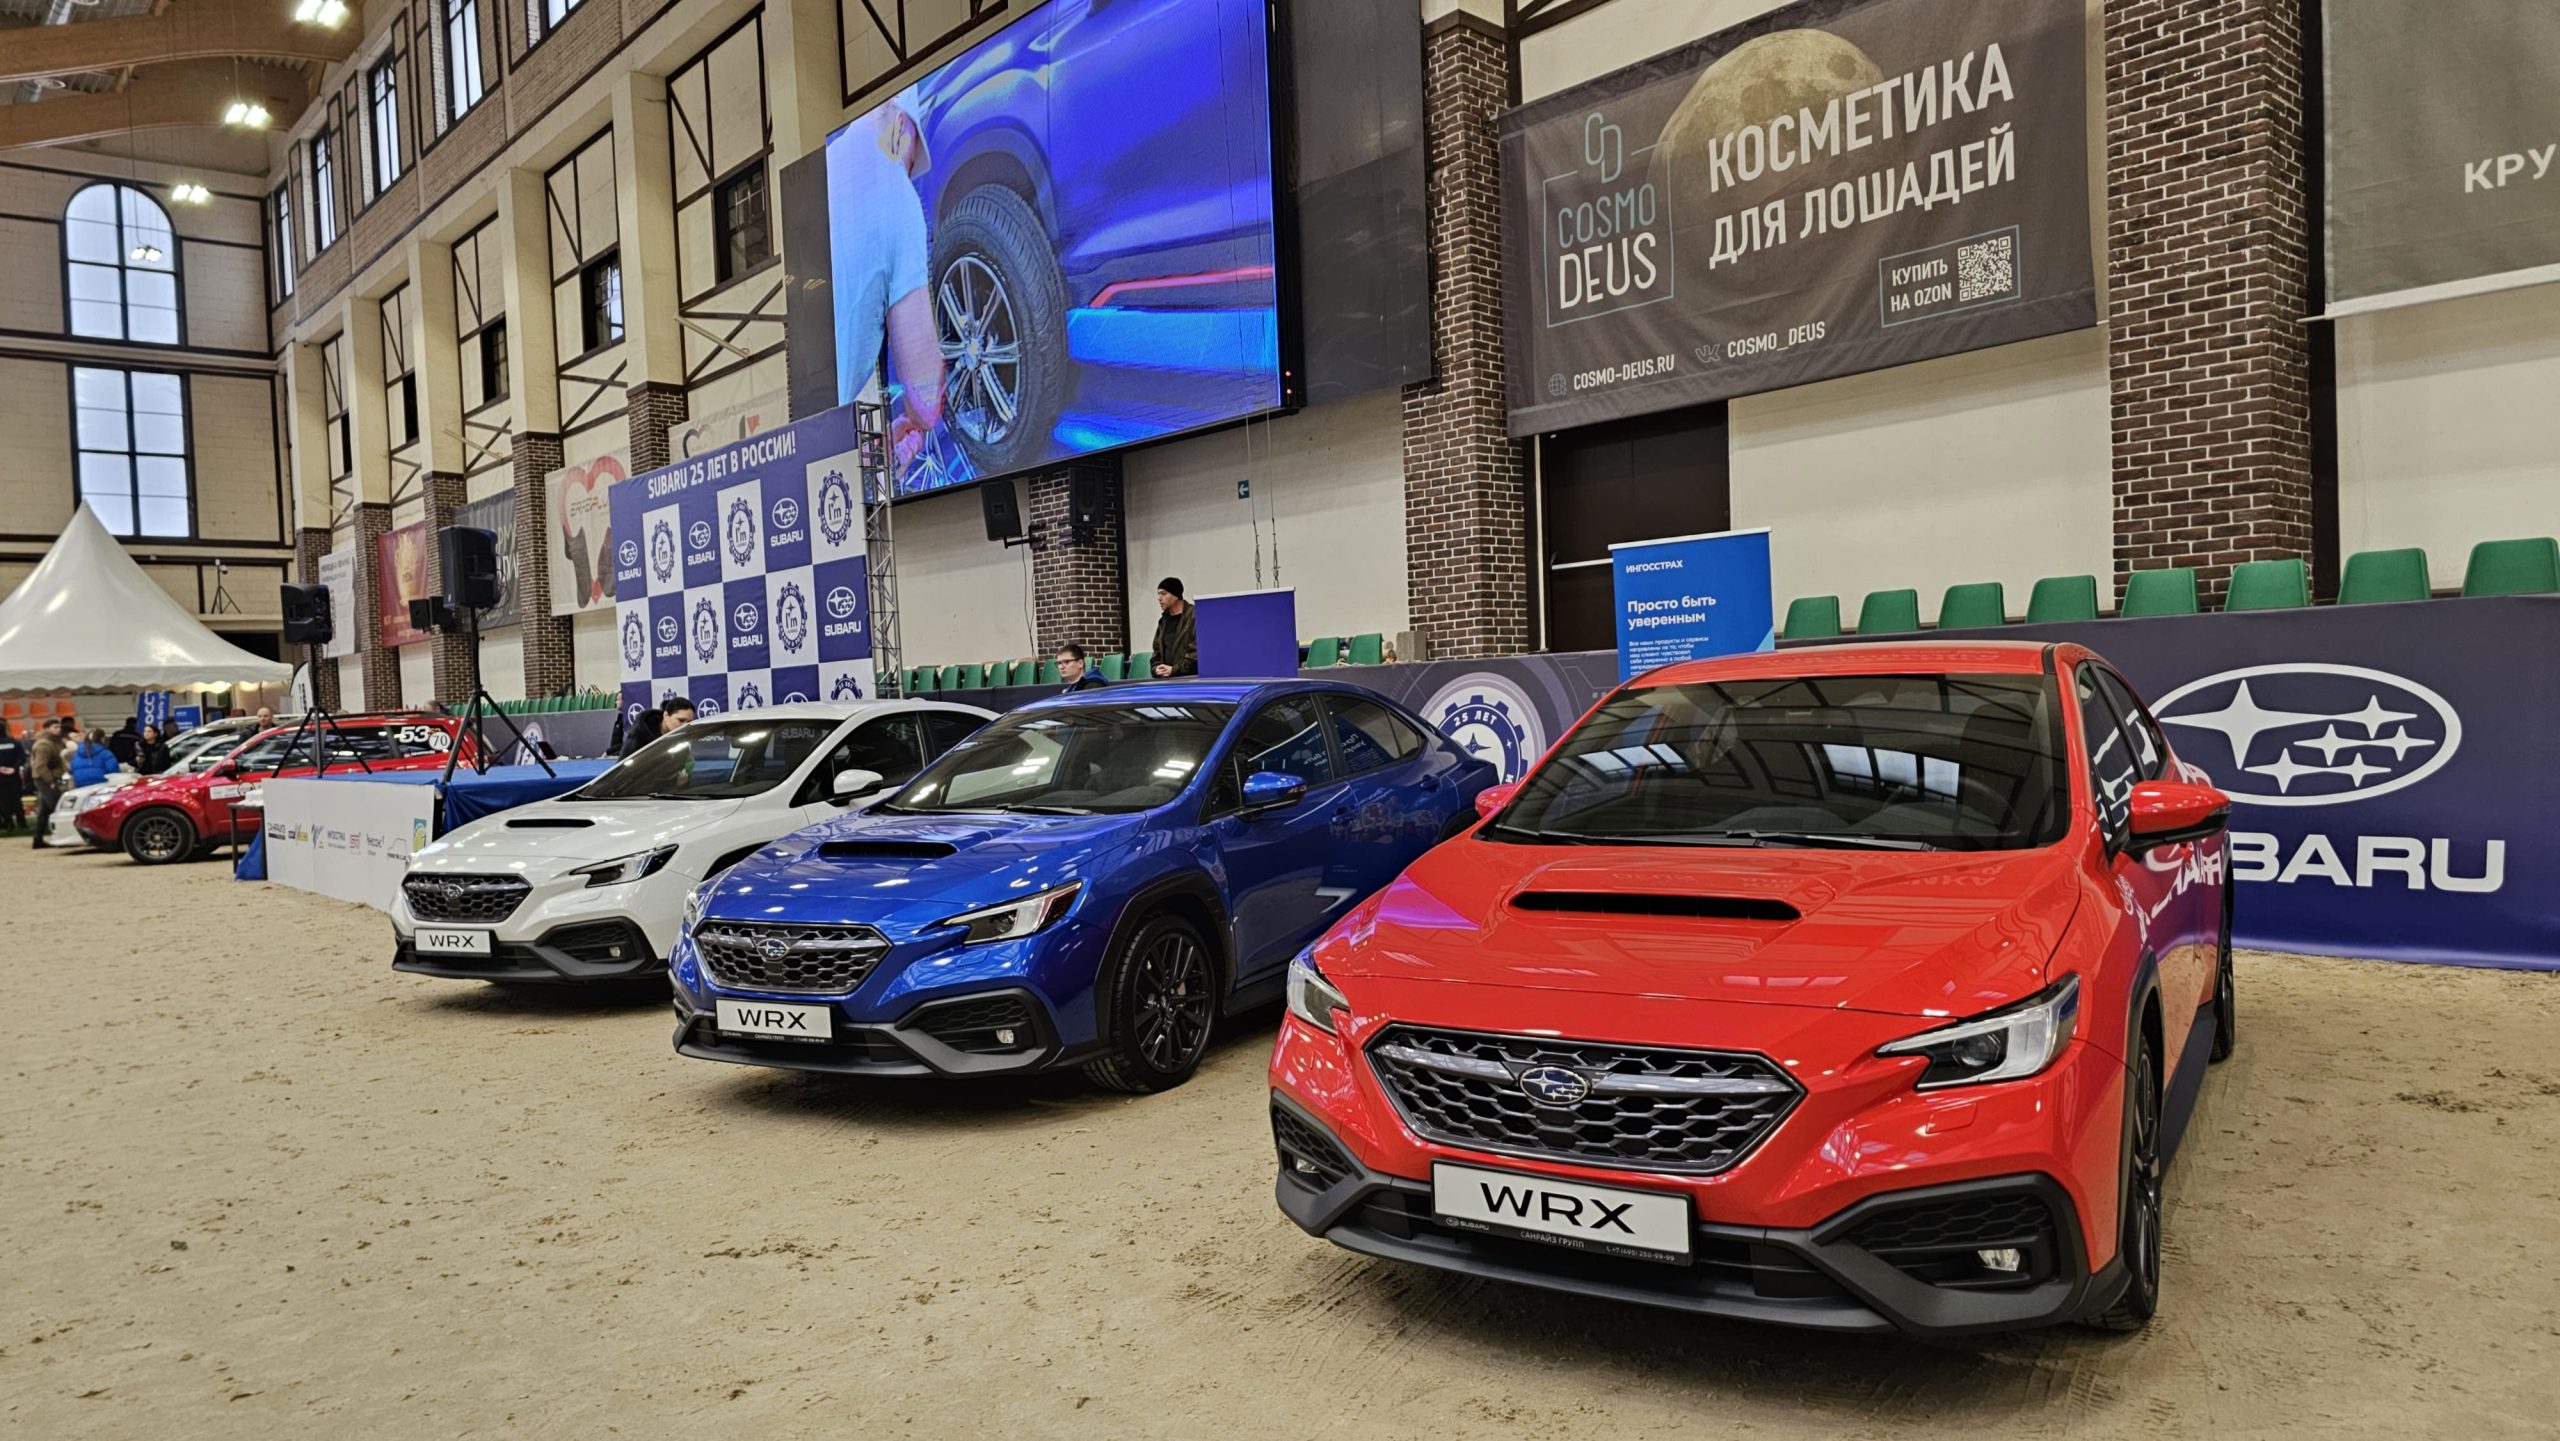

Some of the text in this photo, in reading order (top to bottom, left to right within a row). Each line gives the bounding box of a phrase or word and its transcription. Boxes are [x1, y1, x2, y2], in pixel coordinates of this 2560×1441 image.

[1707, 42, 2015, 193] КОСМЕТИКА
[1708, 121, 2016, 270] ДЛЯ ЛОШАДЕЙ
[1558, 182, 1656, 249] COSMO
[1559, 231, 1658, 310] DEUS
[1891, 258, 1949, 287] КУПИТЬ
[1890, 283, 1953, 313] НА OZON
[1727, 321, 1826, 359] COSMO_DEUS
[1573, 354, 1675, 392] COSMO-DEUS.RU
[648, 431, 796, 499] SUBARU 25 ЛЕТ В РОССИИ!
[770, 529, 803, 547] SUBARU
[688, 550, 715, 566] SUBARU
[1626, 560, 1683, 574] ИНГОССТРАХ
[618, 567, 642, 582] SUBARU
[1628, 596, 1717, 614] Просто быть
[824, 620, 861, 636] SUBARU
[1628, 613, 1705, 630] уверенным
[732, 634, 762, 648] SUBARU
[656, 645, 681, 657] SUBARU
[1453, 710, 1497, 727] 25 ЛЕТ
[398, 725, 430, 743] 53
[433, 735, 447, 747] 70
[2232, 831, 2506, 893] BARU
[429, 934, 474, 948] WRX
[737, 1008, 807, 1030] WRX
[1480, 1182, 1636, 1234] WRX
[1460, 1221, 1489, 1231] SUBARU
[1520, 1231, 1585, 1248] САНРАЙЗ ГРУПП
